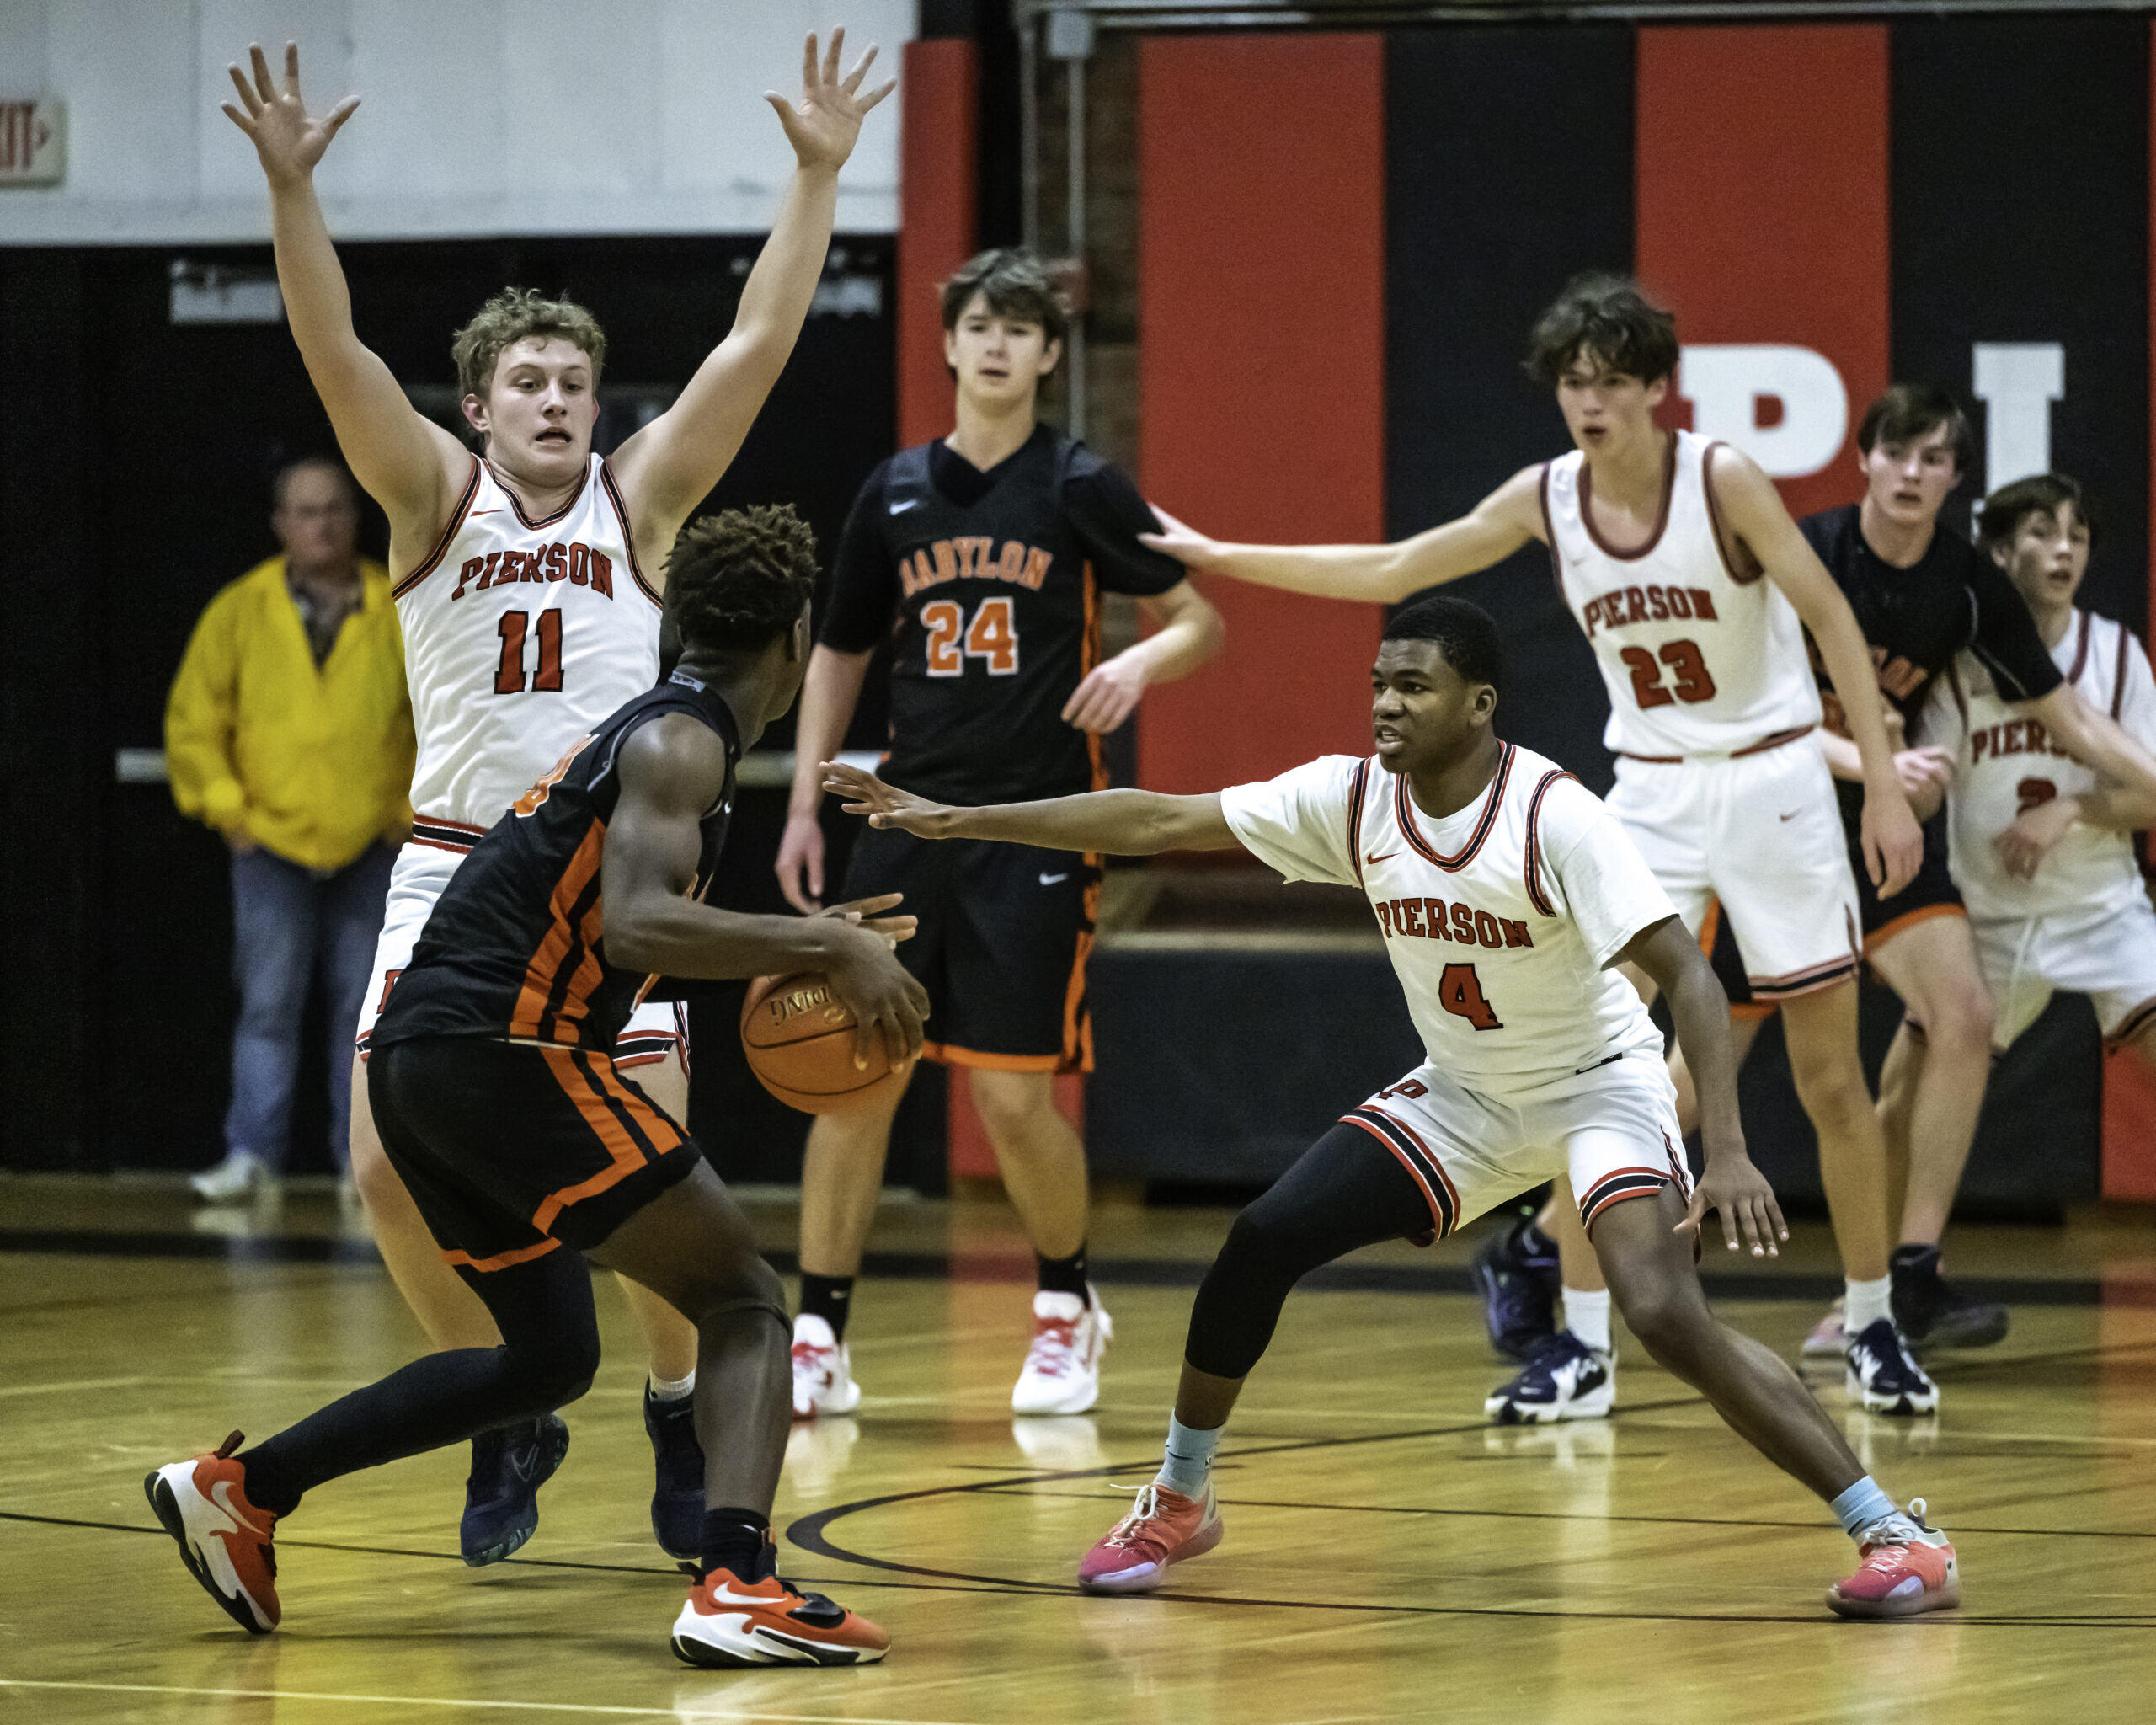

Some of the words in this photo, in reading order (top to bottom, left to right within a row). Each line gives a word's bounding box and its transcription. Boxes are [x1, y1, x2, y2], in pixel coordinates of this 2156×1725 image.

[452, 542, 613, 601] PIERSON
[920, 596, 1018, 676] 24
[1583, 585, 1718, 638] PIERSON
[494, 608, 564, 694] 11
[1620, 639, 1716, 709] 23
[1972, 718, 2084, 766] PIER
[1375, 897, 1534, 948] PIERSON
[1438, 963, 1503, 1031] 4
